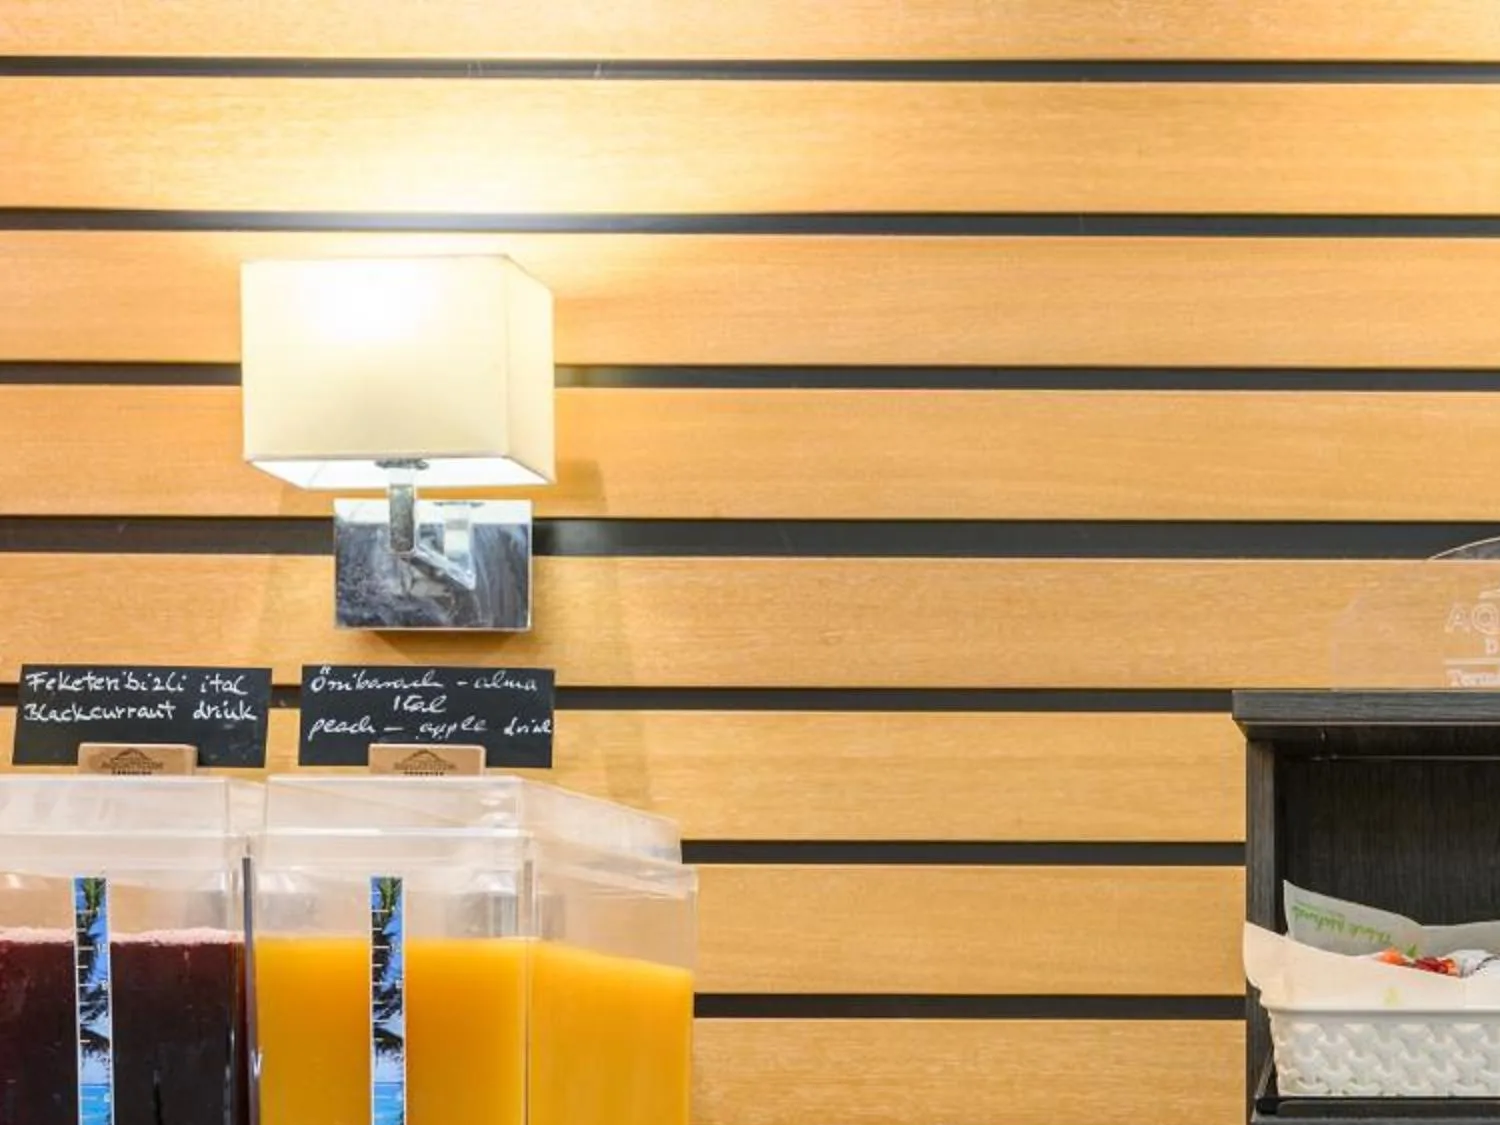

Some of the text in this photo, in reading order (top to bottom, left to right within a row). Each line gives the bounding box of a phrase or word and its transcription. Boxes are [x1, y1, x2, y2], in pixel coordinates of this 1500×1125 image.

[473, 671, 538, 691] alma
[23, 700, 257, 722] Blackcurrant drink
[308, 716, 376, 741] peach
[419, 715, 488, 740] apple
